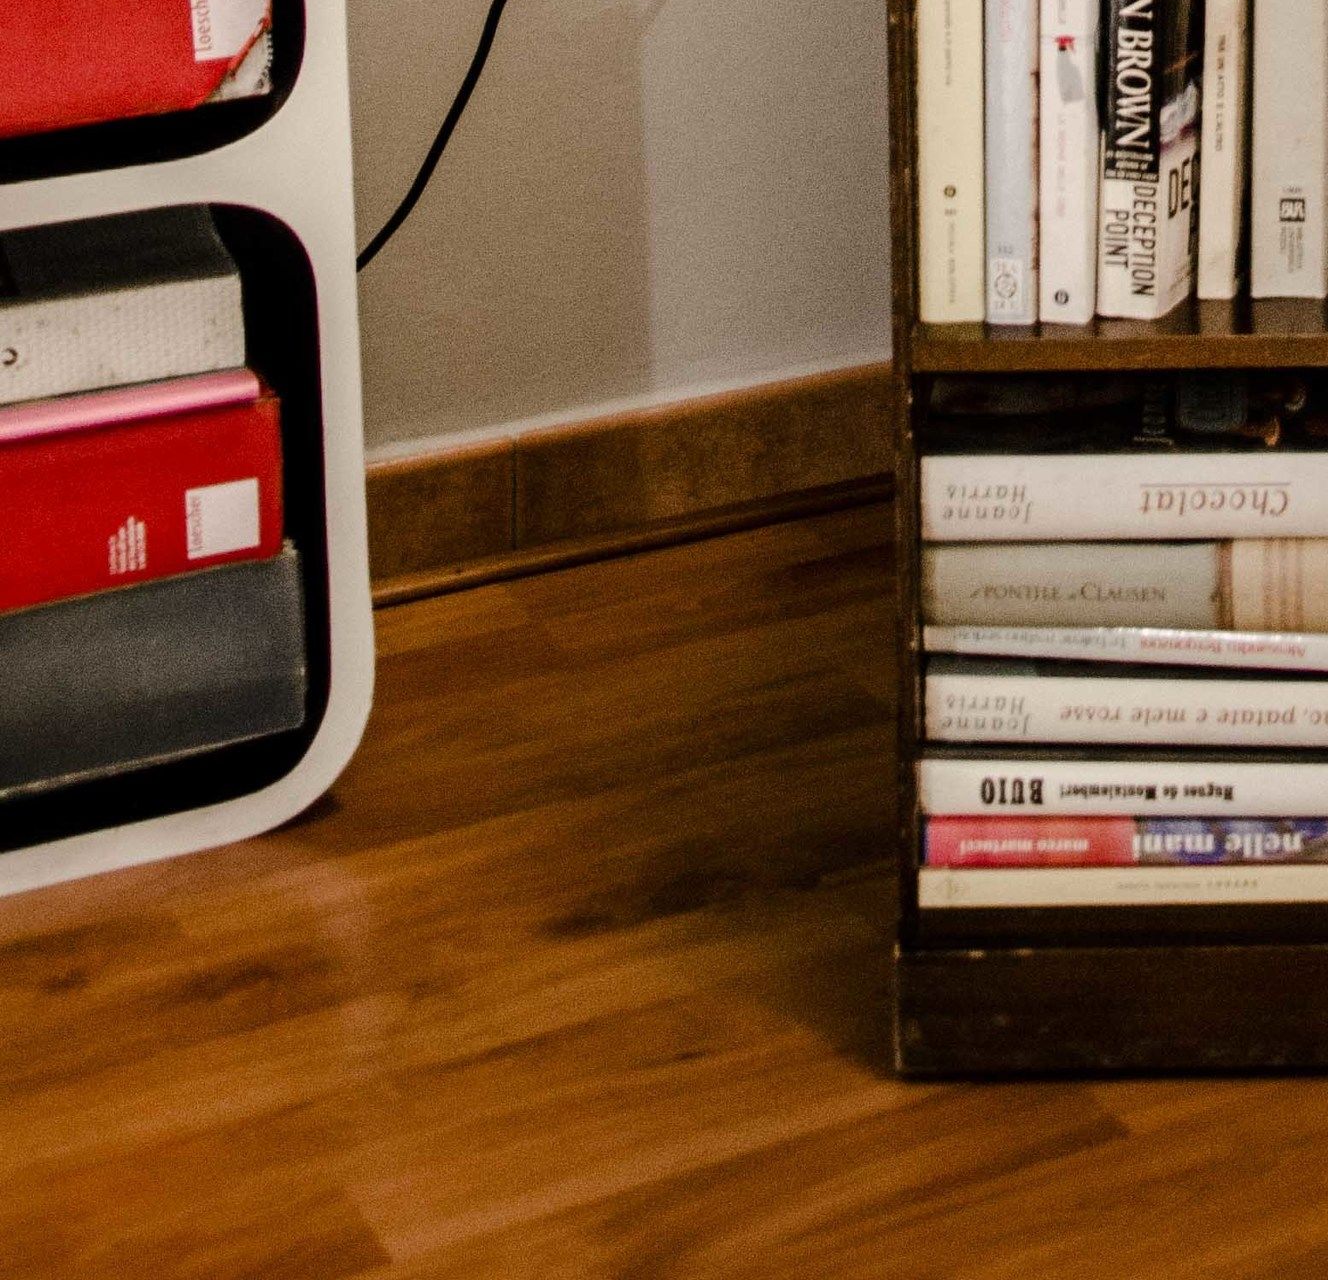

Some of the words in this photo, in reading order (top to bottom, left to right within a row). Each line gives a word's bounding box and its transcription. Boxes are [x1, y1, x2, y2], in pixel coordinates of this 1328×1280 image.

[1114, 27, 1153, 148] BROWN
[1103, 209, 1130, 267] POINT
[1130, 183, 1157, 295] DECEPTION
[945, 484, 1025, 503] Harris
[1138, 489, 1289, 516] Chocolat
[942, 501, 1032, 523] Joanne
[943, 692, 1024, 711] Harris
[1058, 703, 1122, 722] rosse
[939, 710, 1031, 734] Joanne
[1128, 705, 1186, 726] mele
[1194, 707, 1208, 722] e
[1214, 703, 1297, 728] patate
[980, 777, 1043, 805] BUIO
[1162, 785, 1178, 801] de
[1182, 784, 1233, 801] Hugues
[1131, 832, 1214, 858] mani
[1223, 831, 1302, 857] nelle
